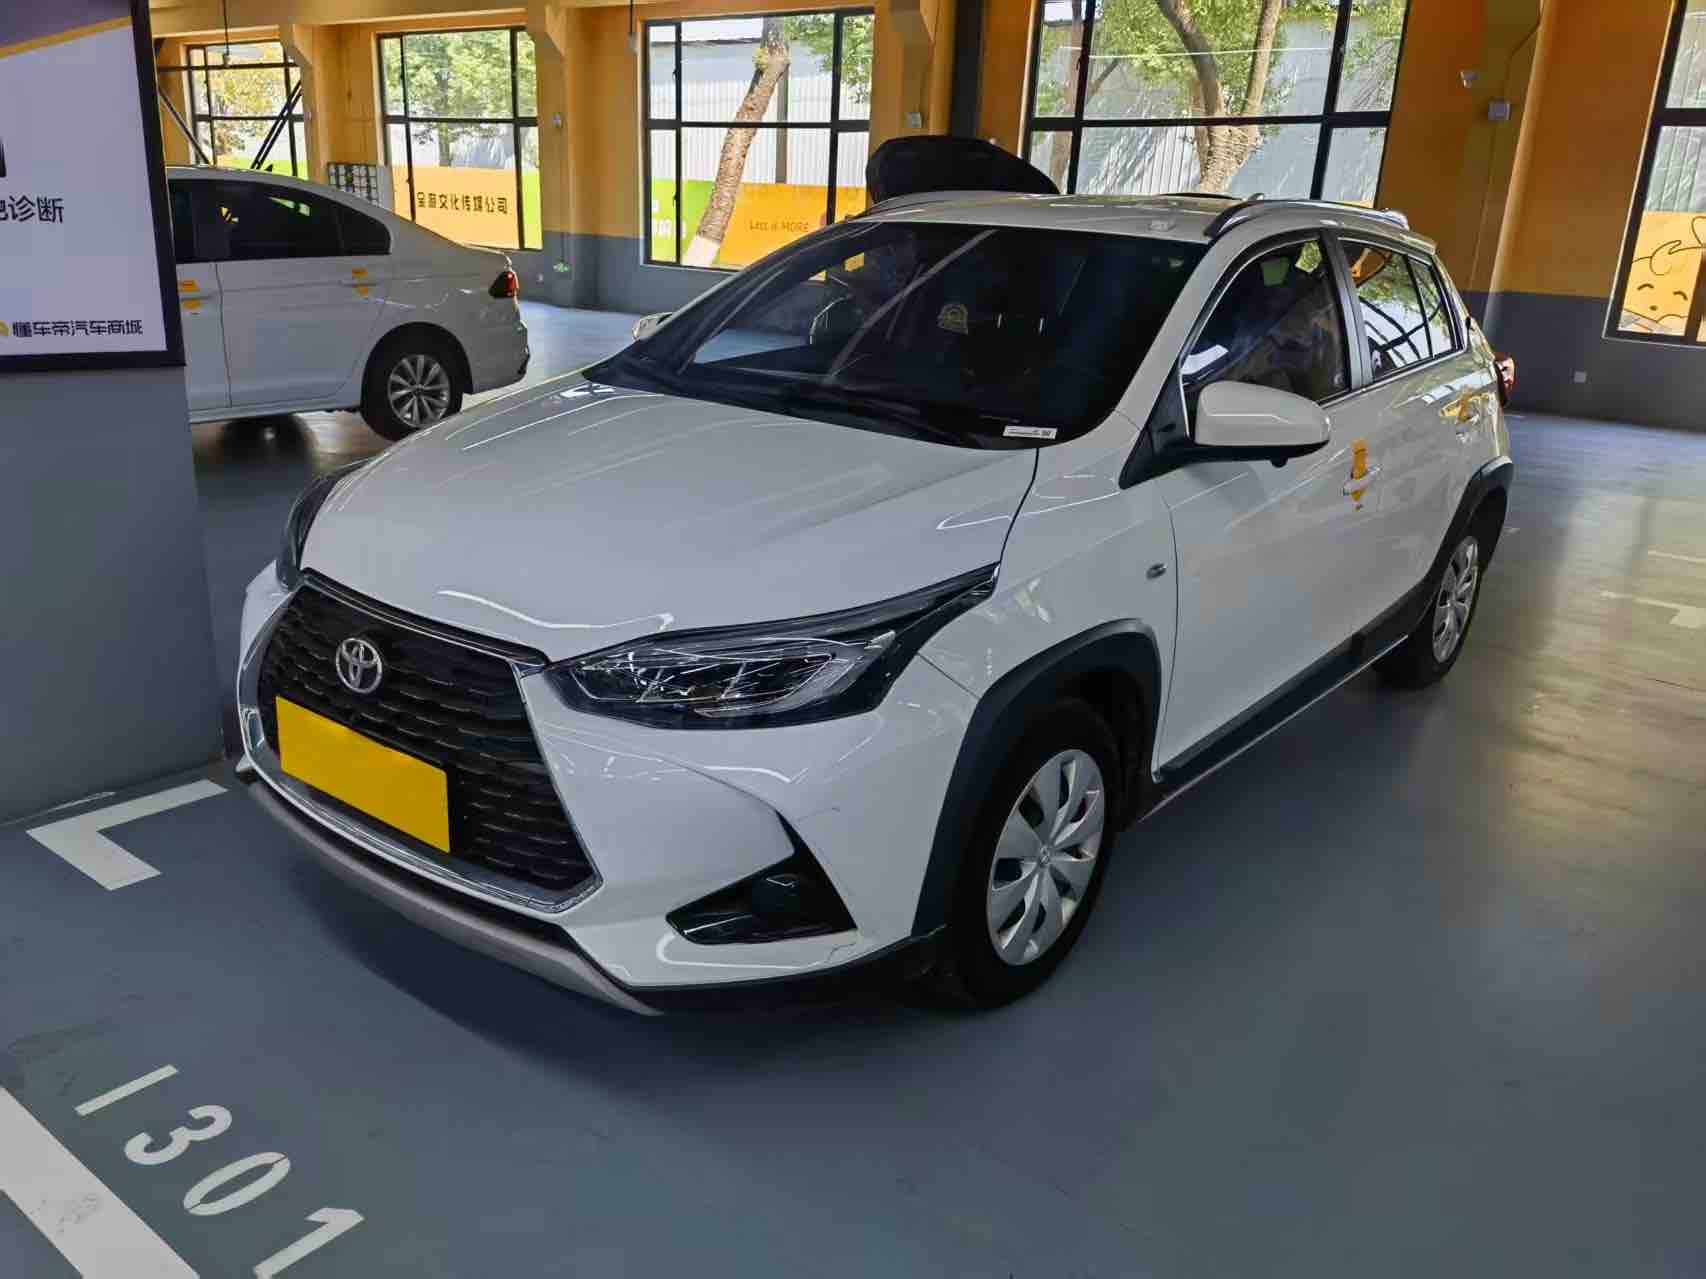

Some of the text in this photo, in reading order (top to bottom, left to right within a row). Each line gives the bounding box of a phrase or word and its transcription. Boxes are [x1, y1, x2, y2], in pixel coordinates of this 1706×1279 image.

[12, 319, 143, 337] 懂车帝汽车商城
